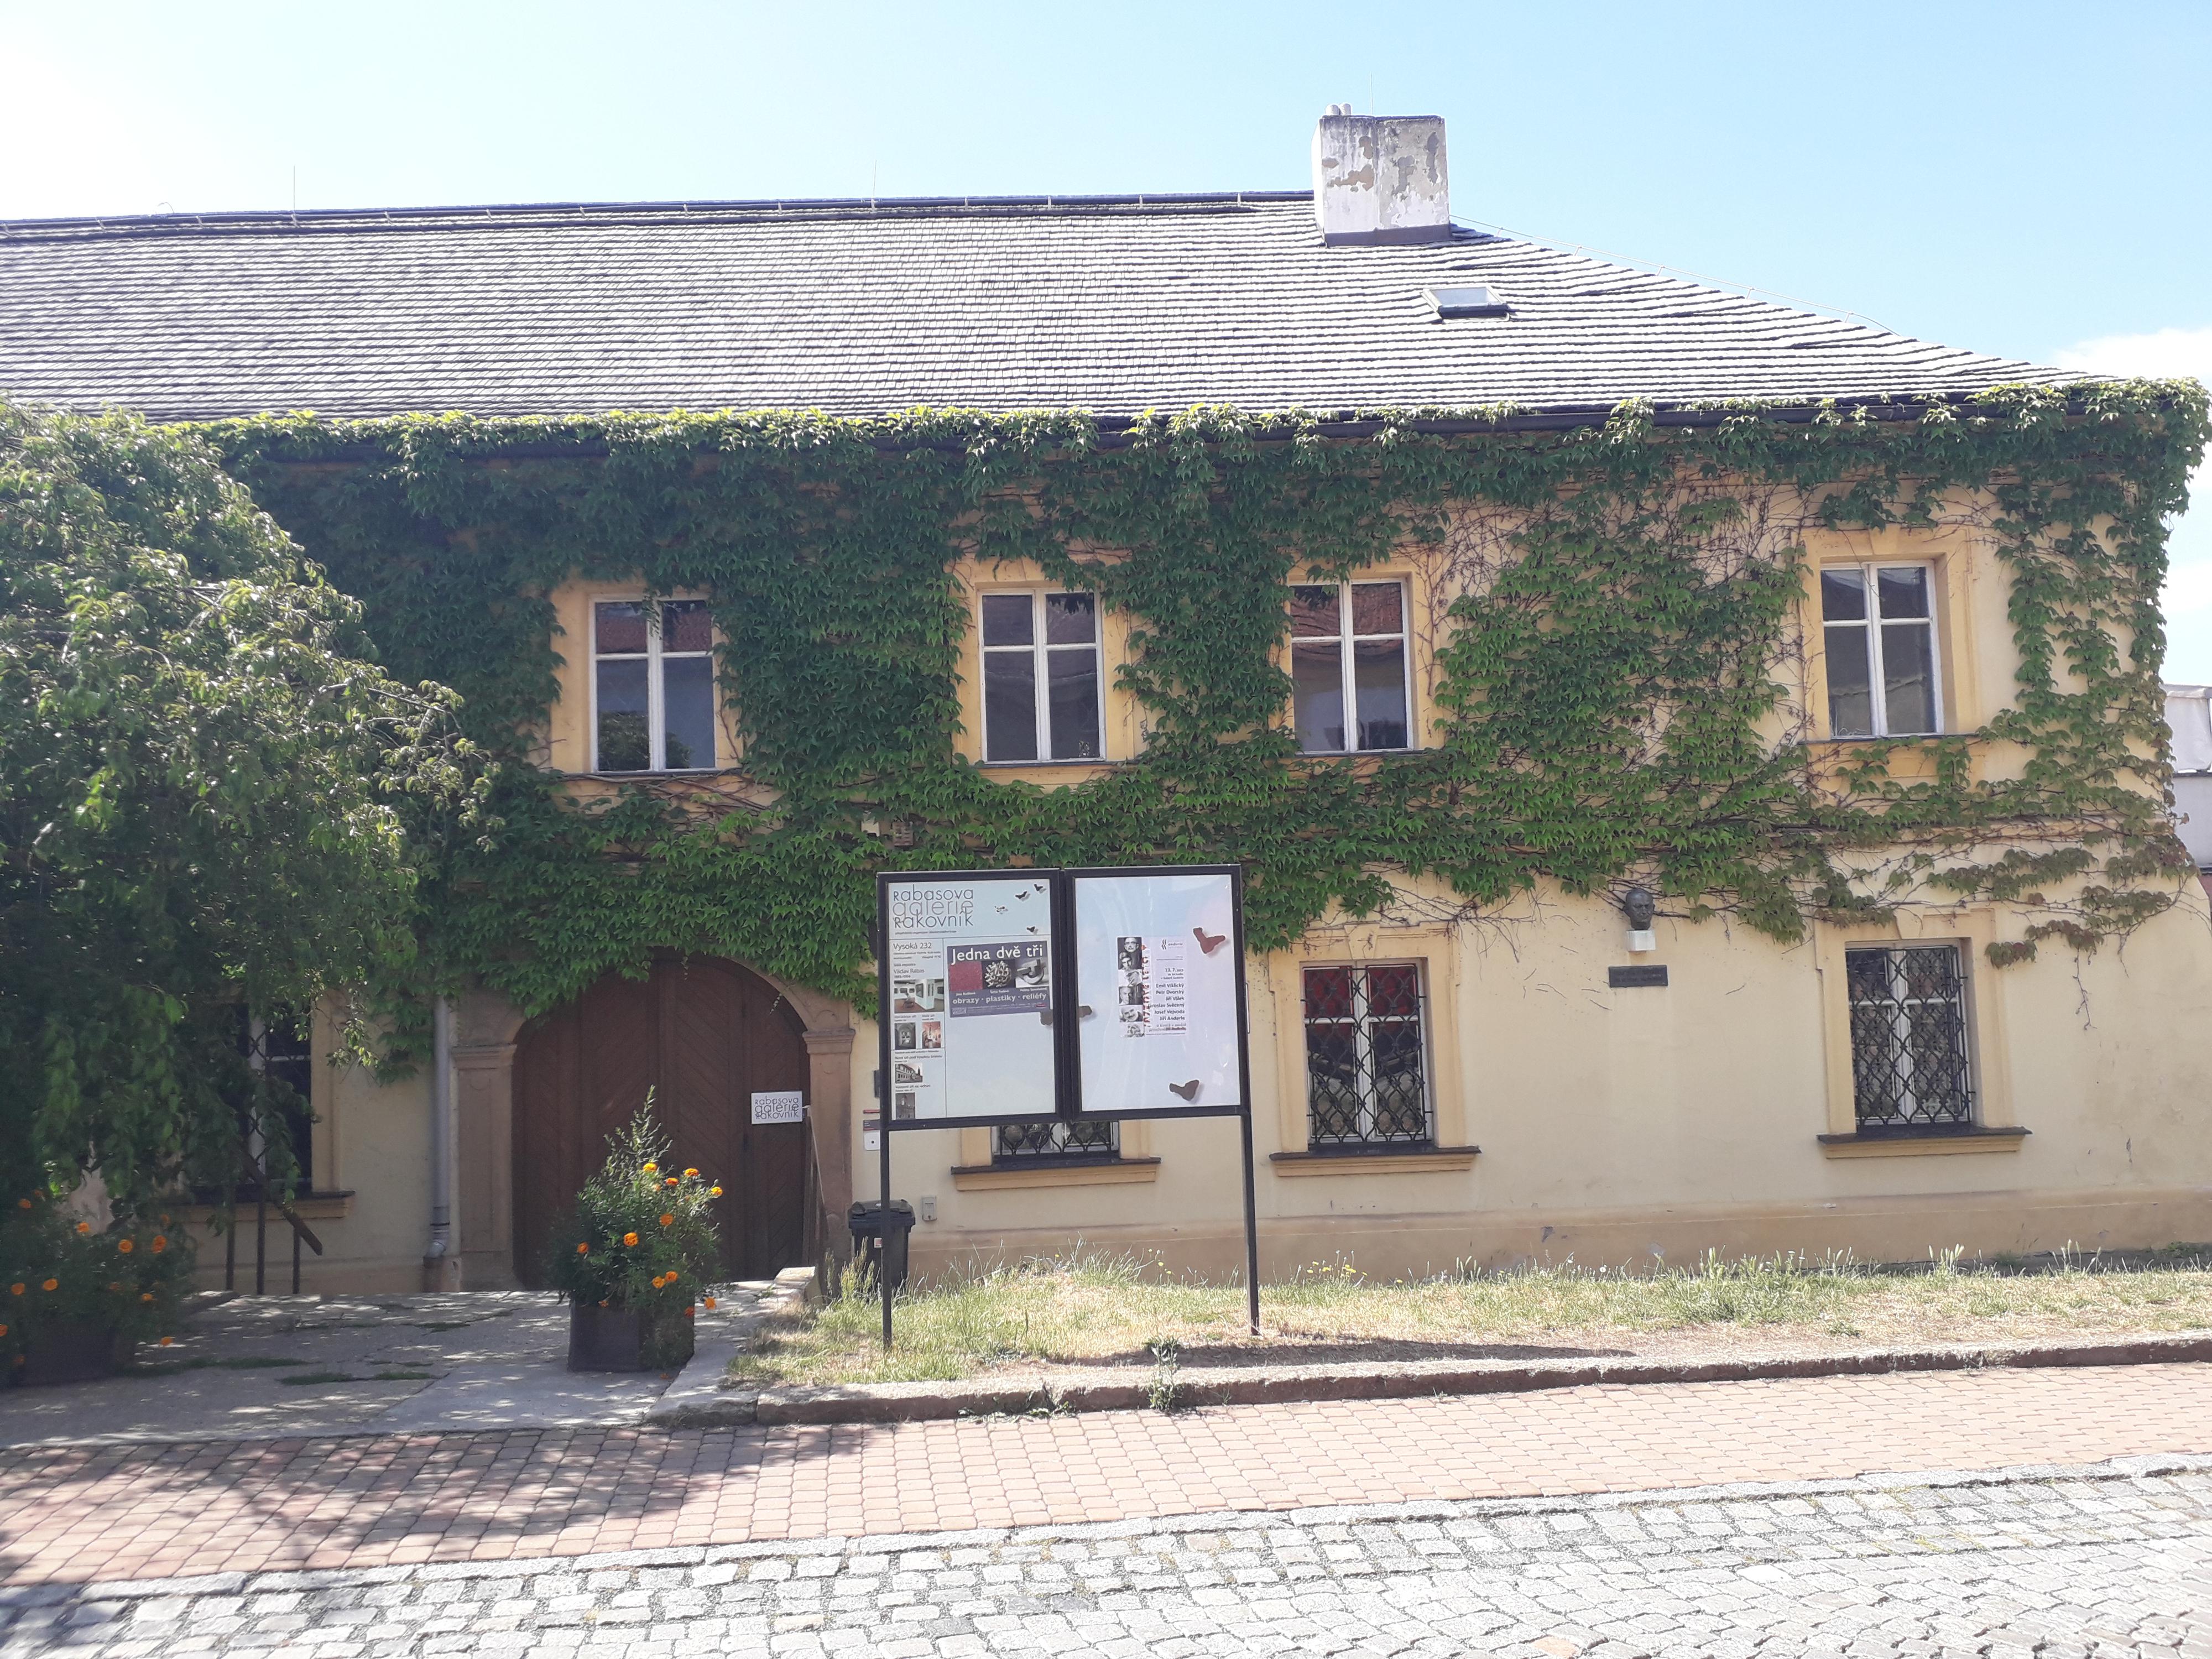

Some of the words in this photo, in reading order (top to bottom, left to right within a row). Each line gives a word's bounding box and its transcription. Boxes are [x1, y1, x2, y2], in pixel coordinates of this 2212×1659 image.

[893, 884, 973, 901] Rabasova
[893, 898, 974, 923] galerie
[894, 907, 974, 928] Rakovník
[893, 942, 918, 951] Vysoká
[951, 947, 991, 966] Jedna
[996, 945, 1021, 959] dvě
[1026, 944, 1044, 957] tři
[986, 994, 1016, 1004] plastiky
[1022, 992, 1047, 1000] reliéfy
[755, 1095, 799, 1105] Rabasova
[755, 1102, 800, 1117] galerie
